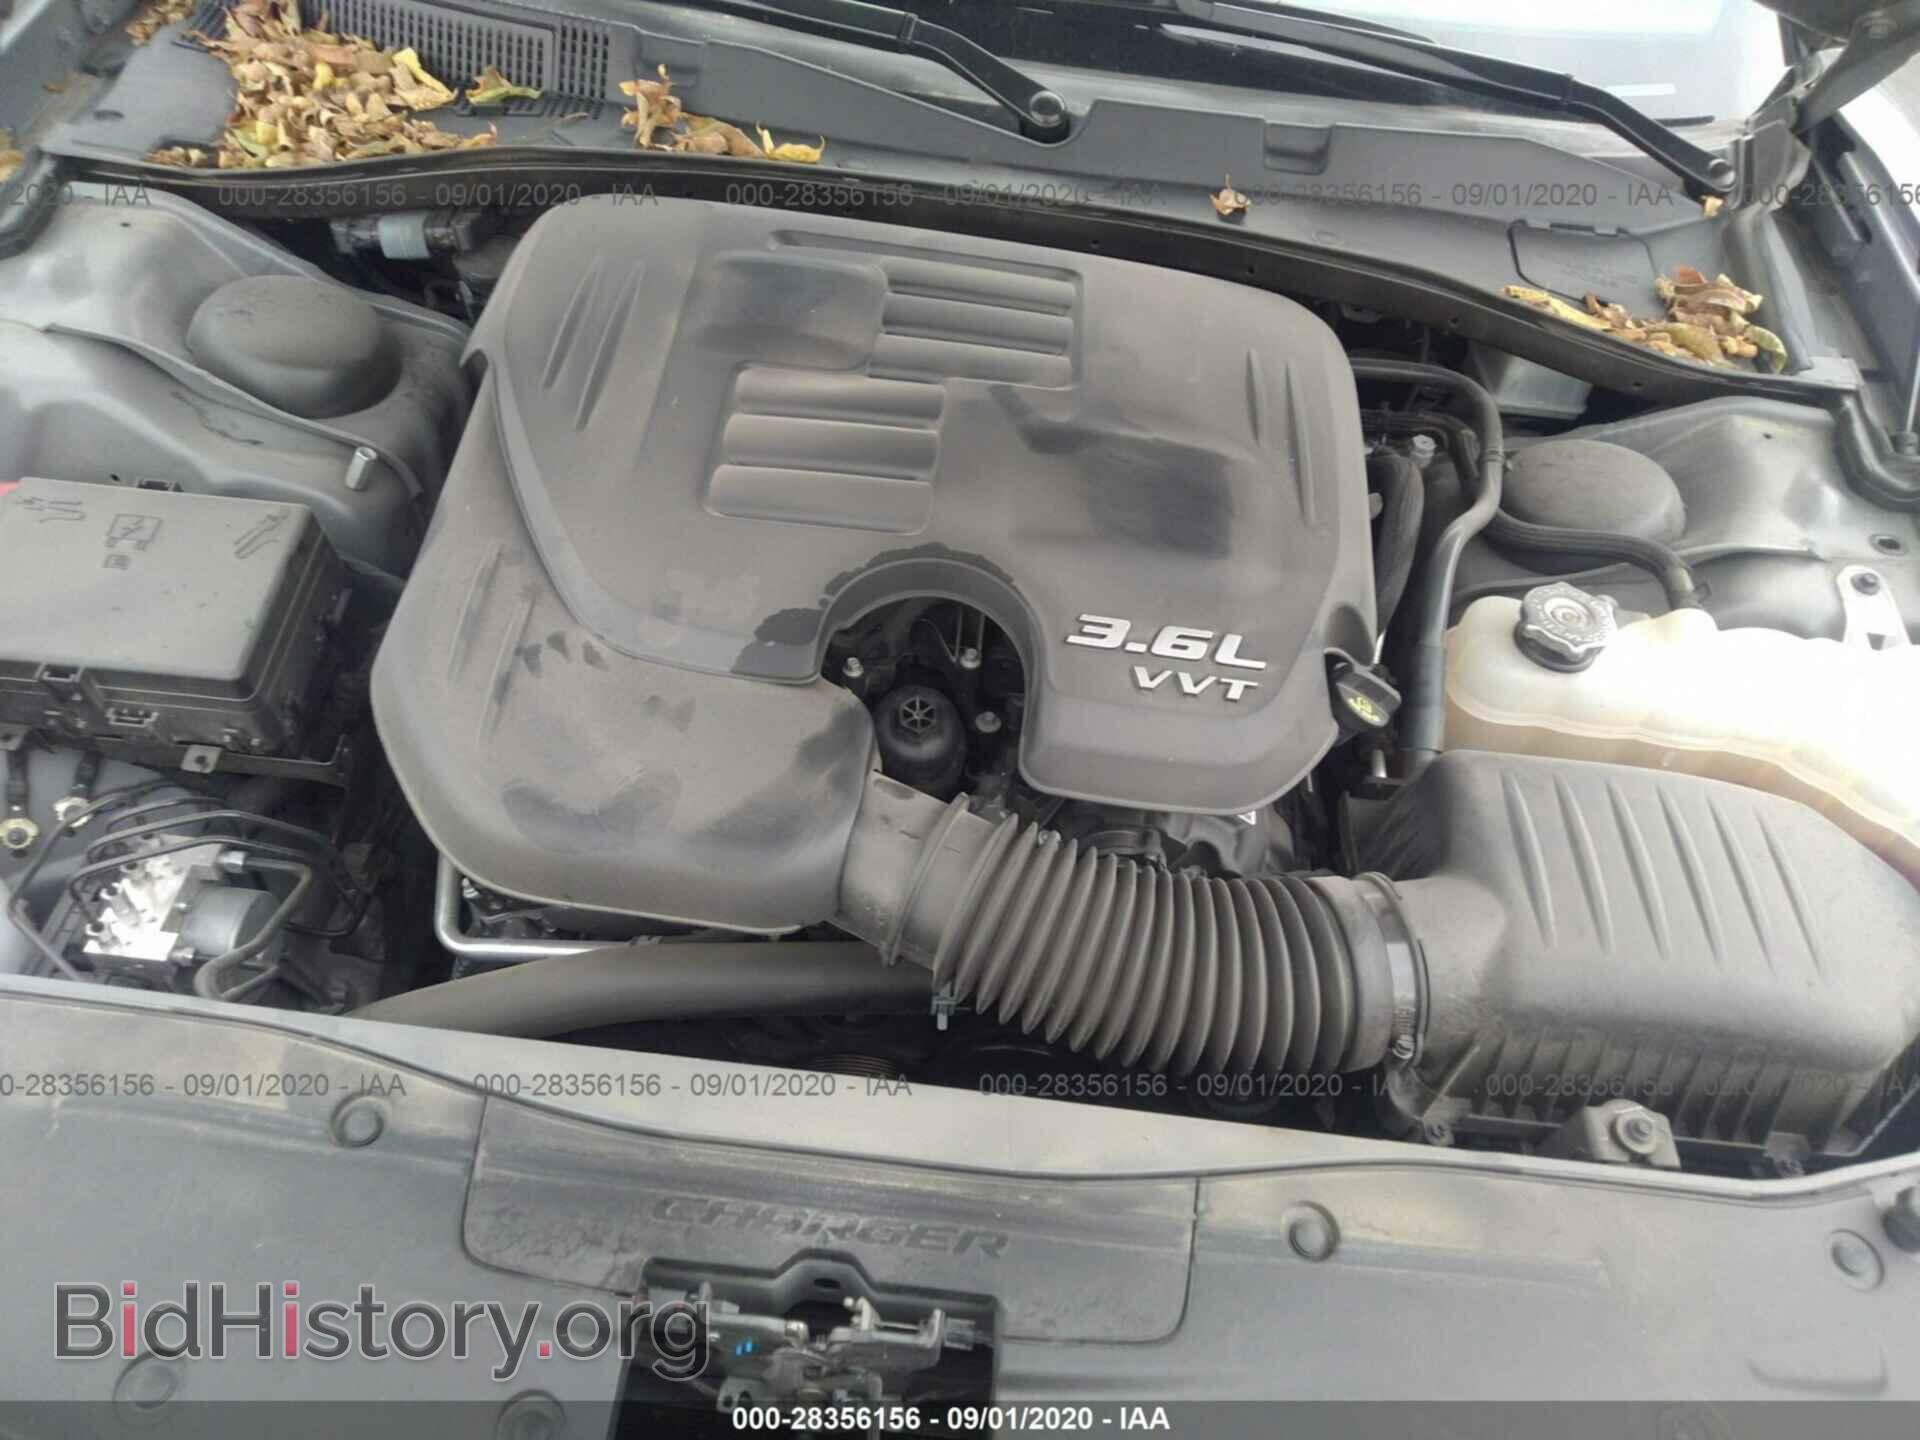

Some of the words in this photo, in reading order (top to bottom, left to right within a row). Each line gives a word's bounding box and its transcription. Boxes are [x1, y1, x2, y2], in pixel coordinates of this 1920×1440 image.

[1065, 613, 1267, 670] 3.6L
[1133, 666, 1259, 702] VVT
[652, 1198, 1010, 1258] CHARGER
